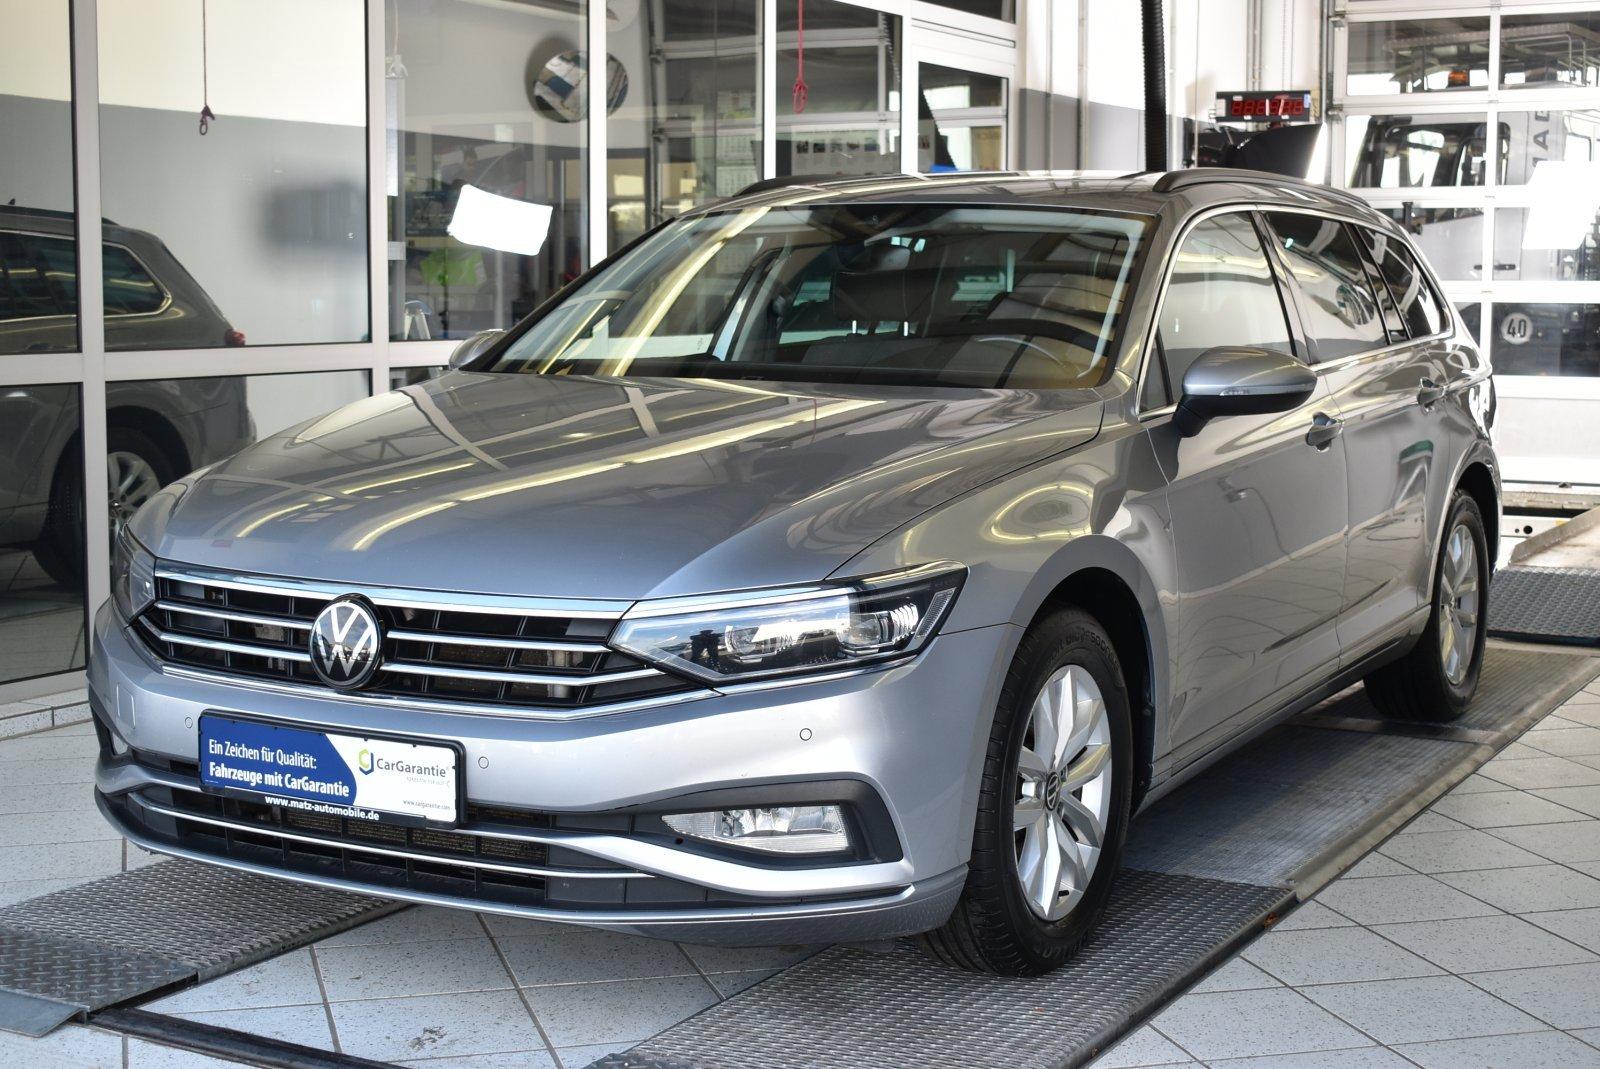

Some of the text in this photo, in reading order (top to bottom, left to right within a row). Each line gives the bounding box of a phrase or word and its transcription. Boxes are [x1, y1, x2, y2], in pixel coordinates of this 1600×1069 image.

[1506, 318, 1527, 338] 40
[208, 738, 317, 769] Ein Zeichen für Qualität:
[209, 761, 350, 797] Fahrzeuge mit CarGarantie
[376, 758, 447, 778] CarGarantie
[264, 795, 380, 821] www.matz-automobile.de
